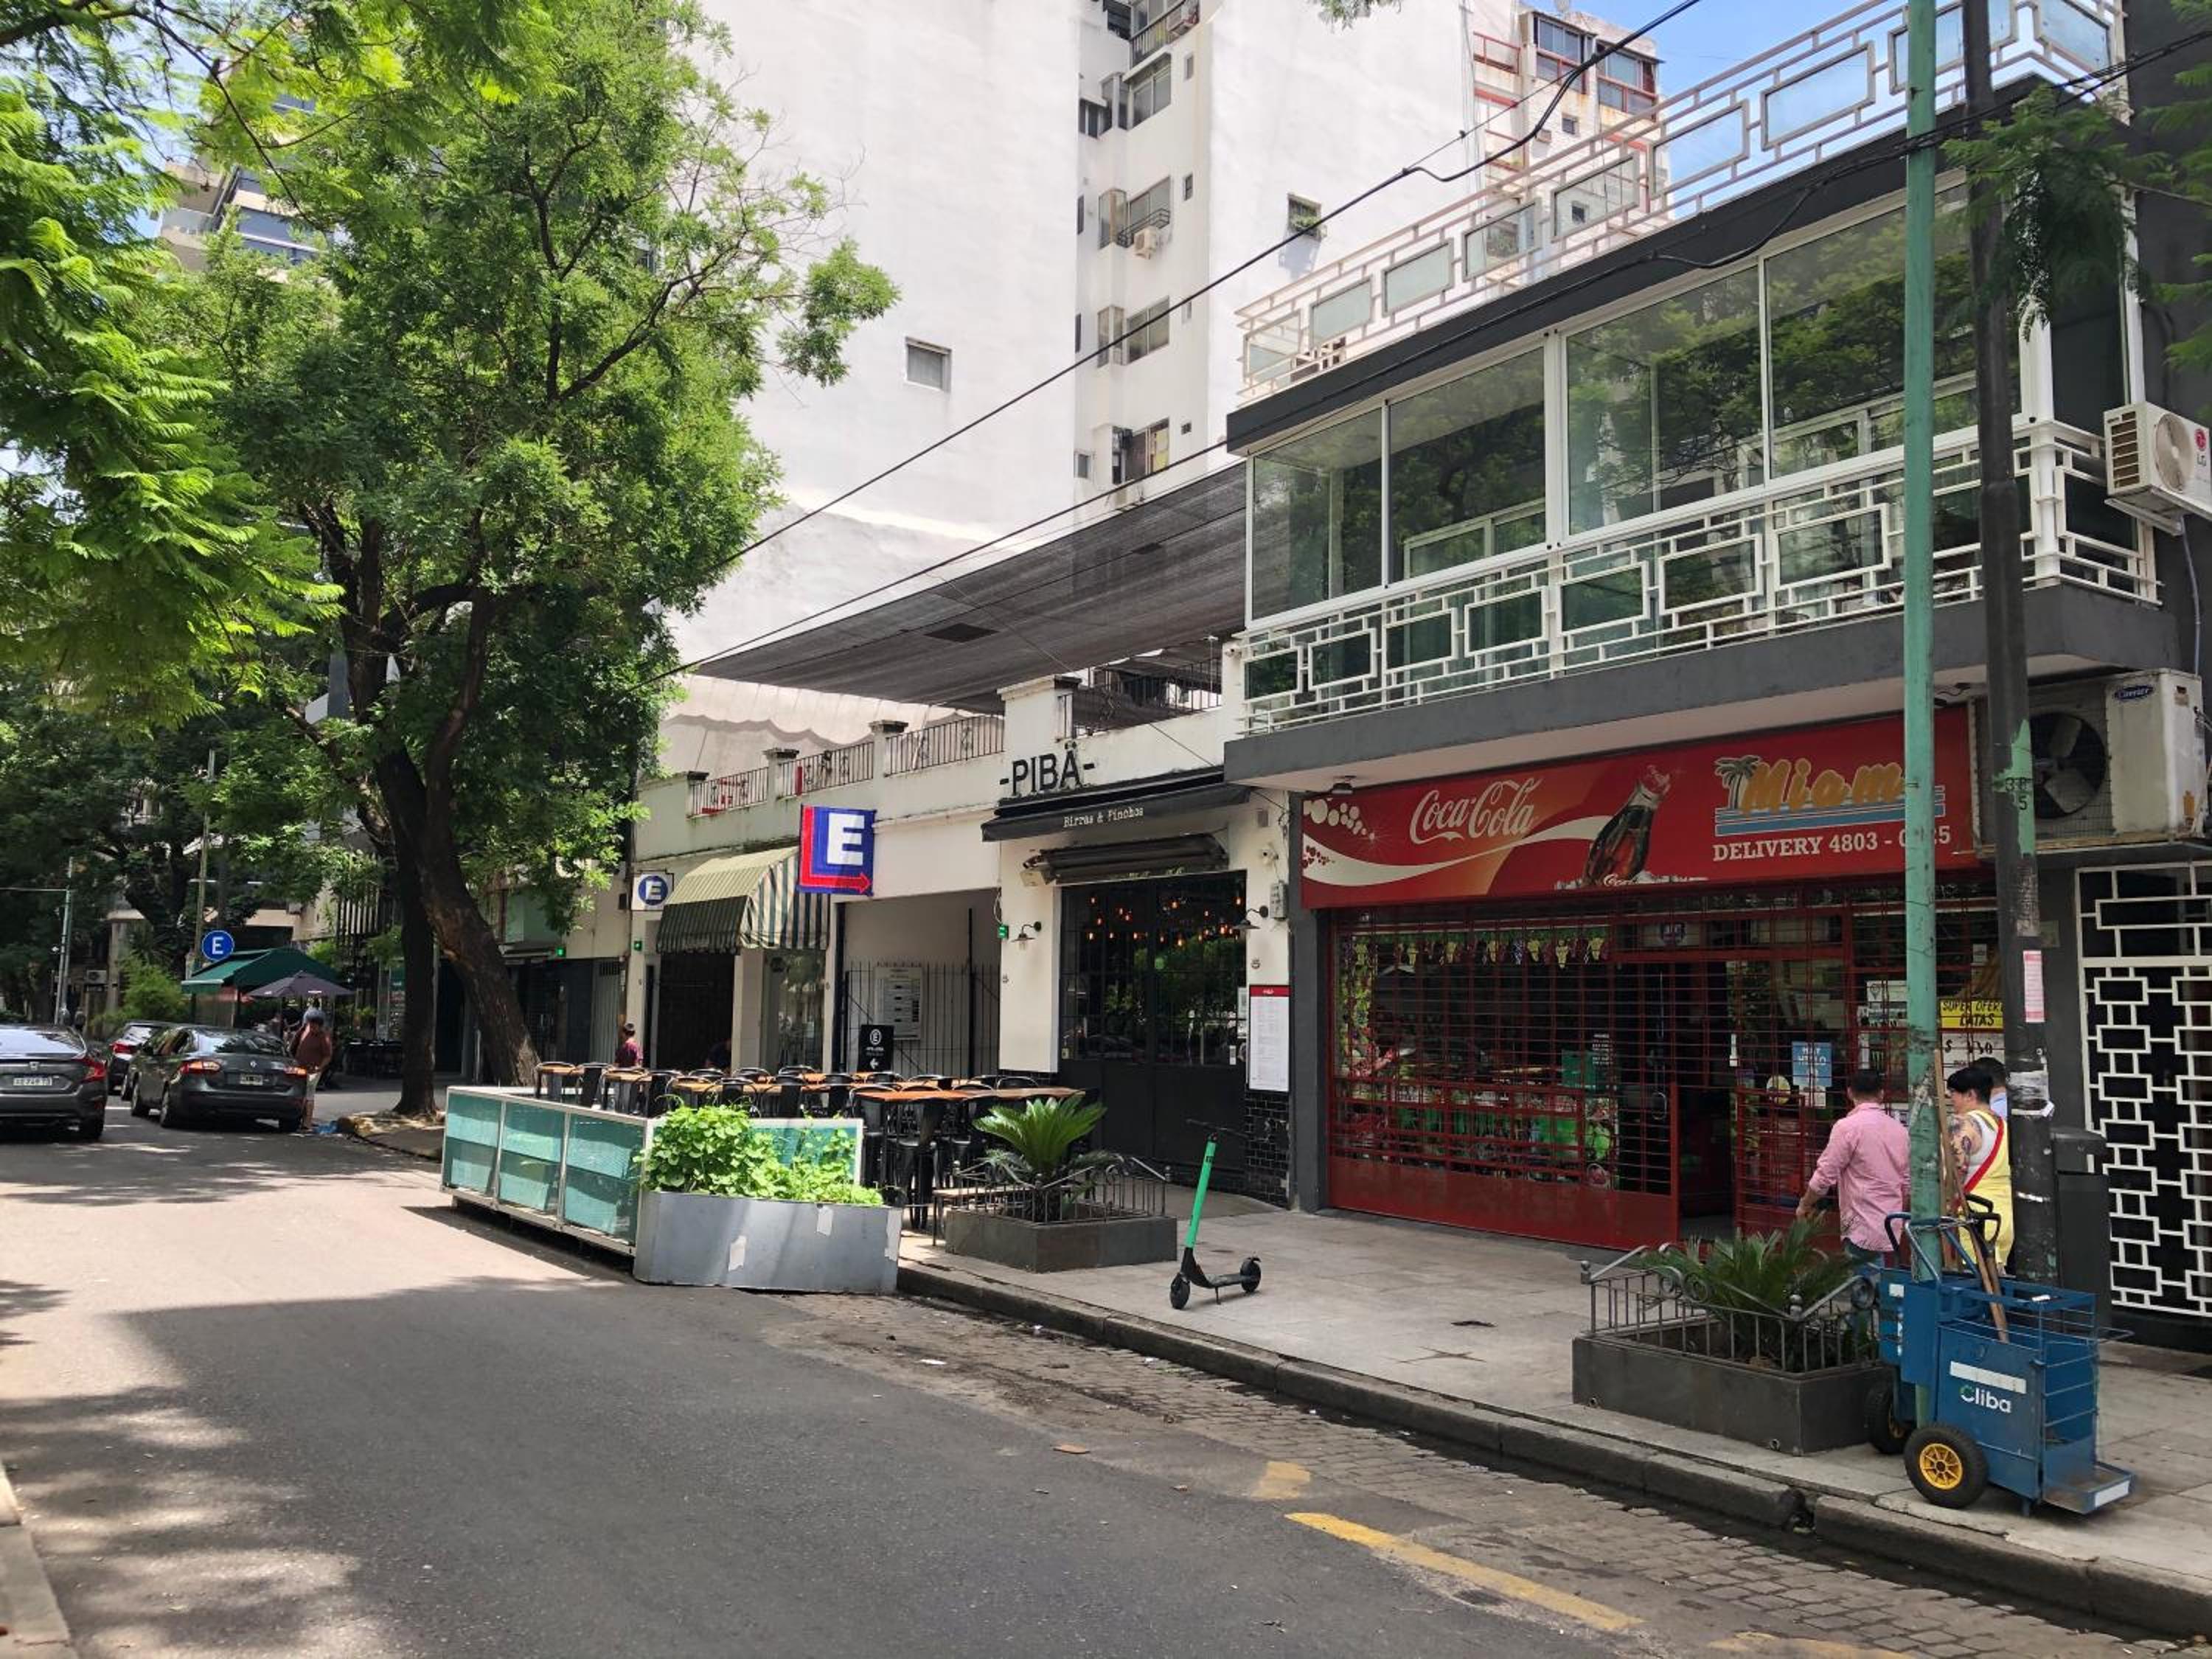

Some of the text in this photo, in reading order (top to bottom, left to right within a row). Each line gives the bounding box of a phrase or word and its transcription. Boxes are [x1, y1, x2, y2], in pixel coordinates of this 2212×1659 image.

[1063, 815, 1093, 827] Birras
[1409, 778, 1543, 844] Coca-Cola
[827, 813, 864, 865] E
[1713, 836, 1823, 861] DELIVERY
[1829, 832, 1877, 853] 4803
[644, 880, 662, 900] E
[212, 936, 224, 954] E
